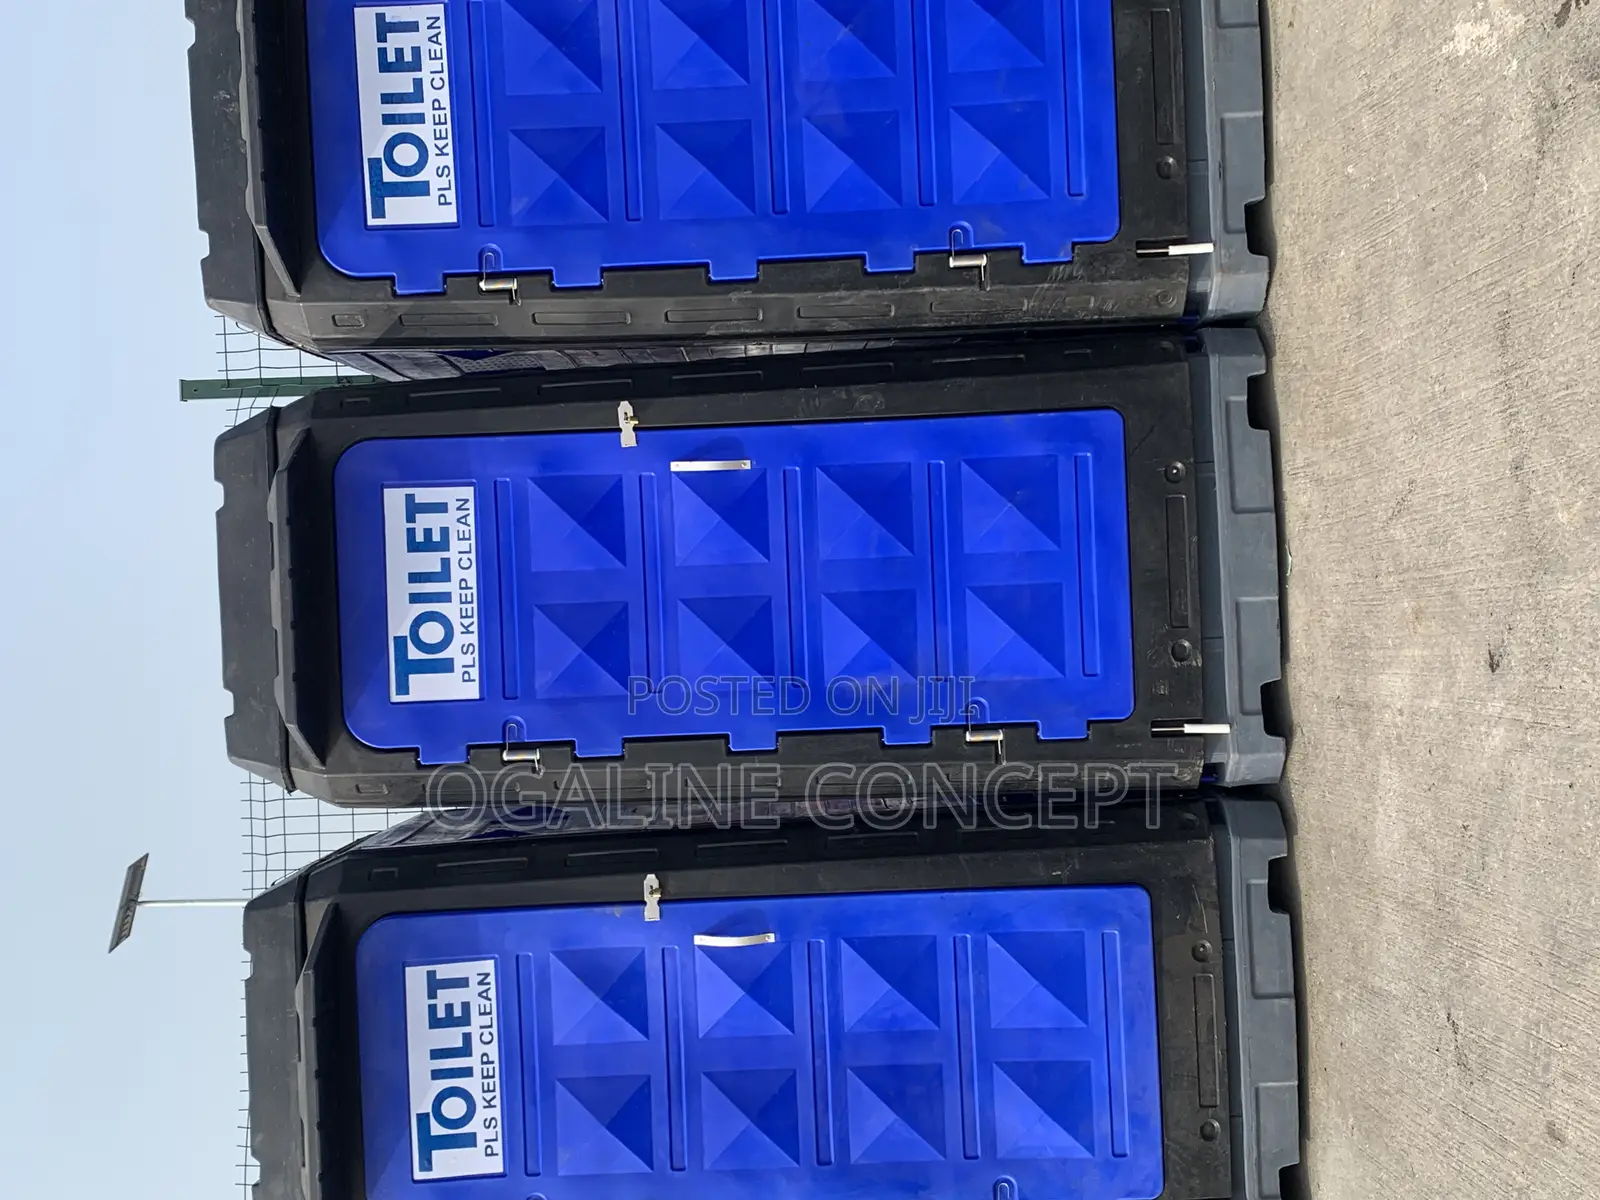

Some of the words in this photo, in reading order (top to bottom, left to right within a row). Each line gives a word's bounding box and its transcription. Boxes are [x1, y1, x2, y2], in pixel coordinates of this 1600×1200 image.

[426, 16, 444, 90] CLEAN
[367, 12, 431, 219] TOILET
[432, 98, 449, 157] KEEP
[436, 164, 452, 206] PLS
[456, 498, 472, 571] CLEAN
[393, 493, 455, 696] TOILET
[459, 578, 475, 635] KEEP
[461, 642, 476, 683] PLS
[476, 972, 494, 1045] CLEAN
[416, 969, 478, 1172] TOILET
[481, 1052, 497, 1109] KEEP
[483, 1117, 498, 1157] PLS
